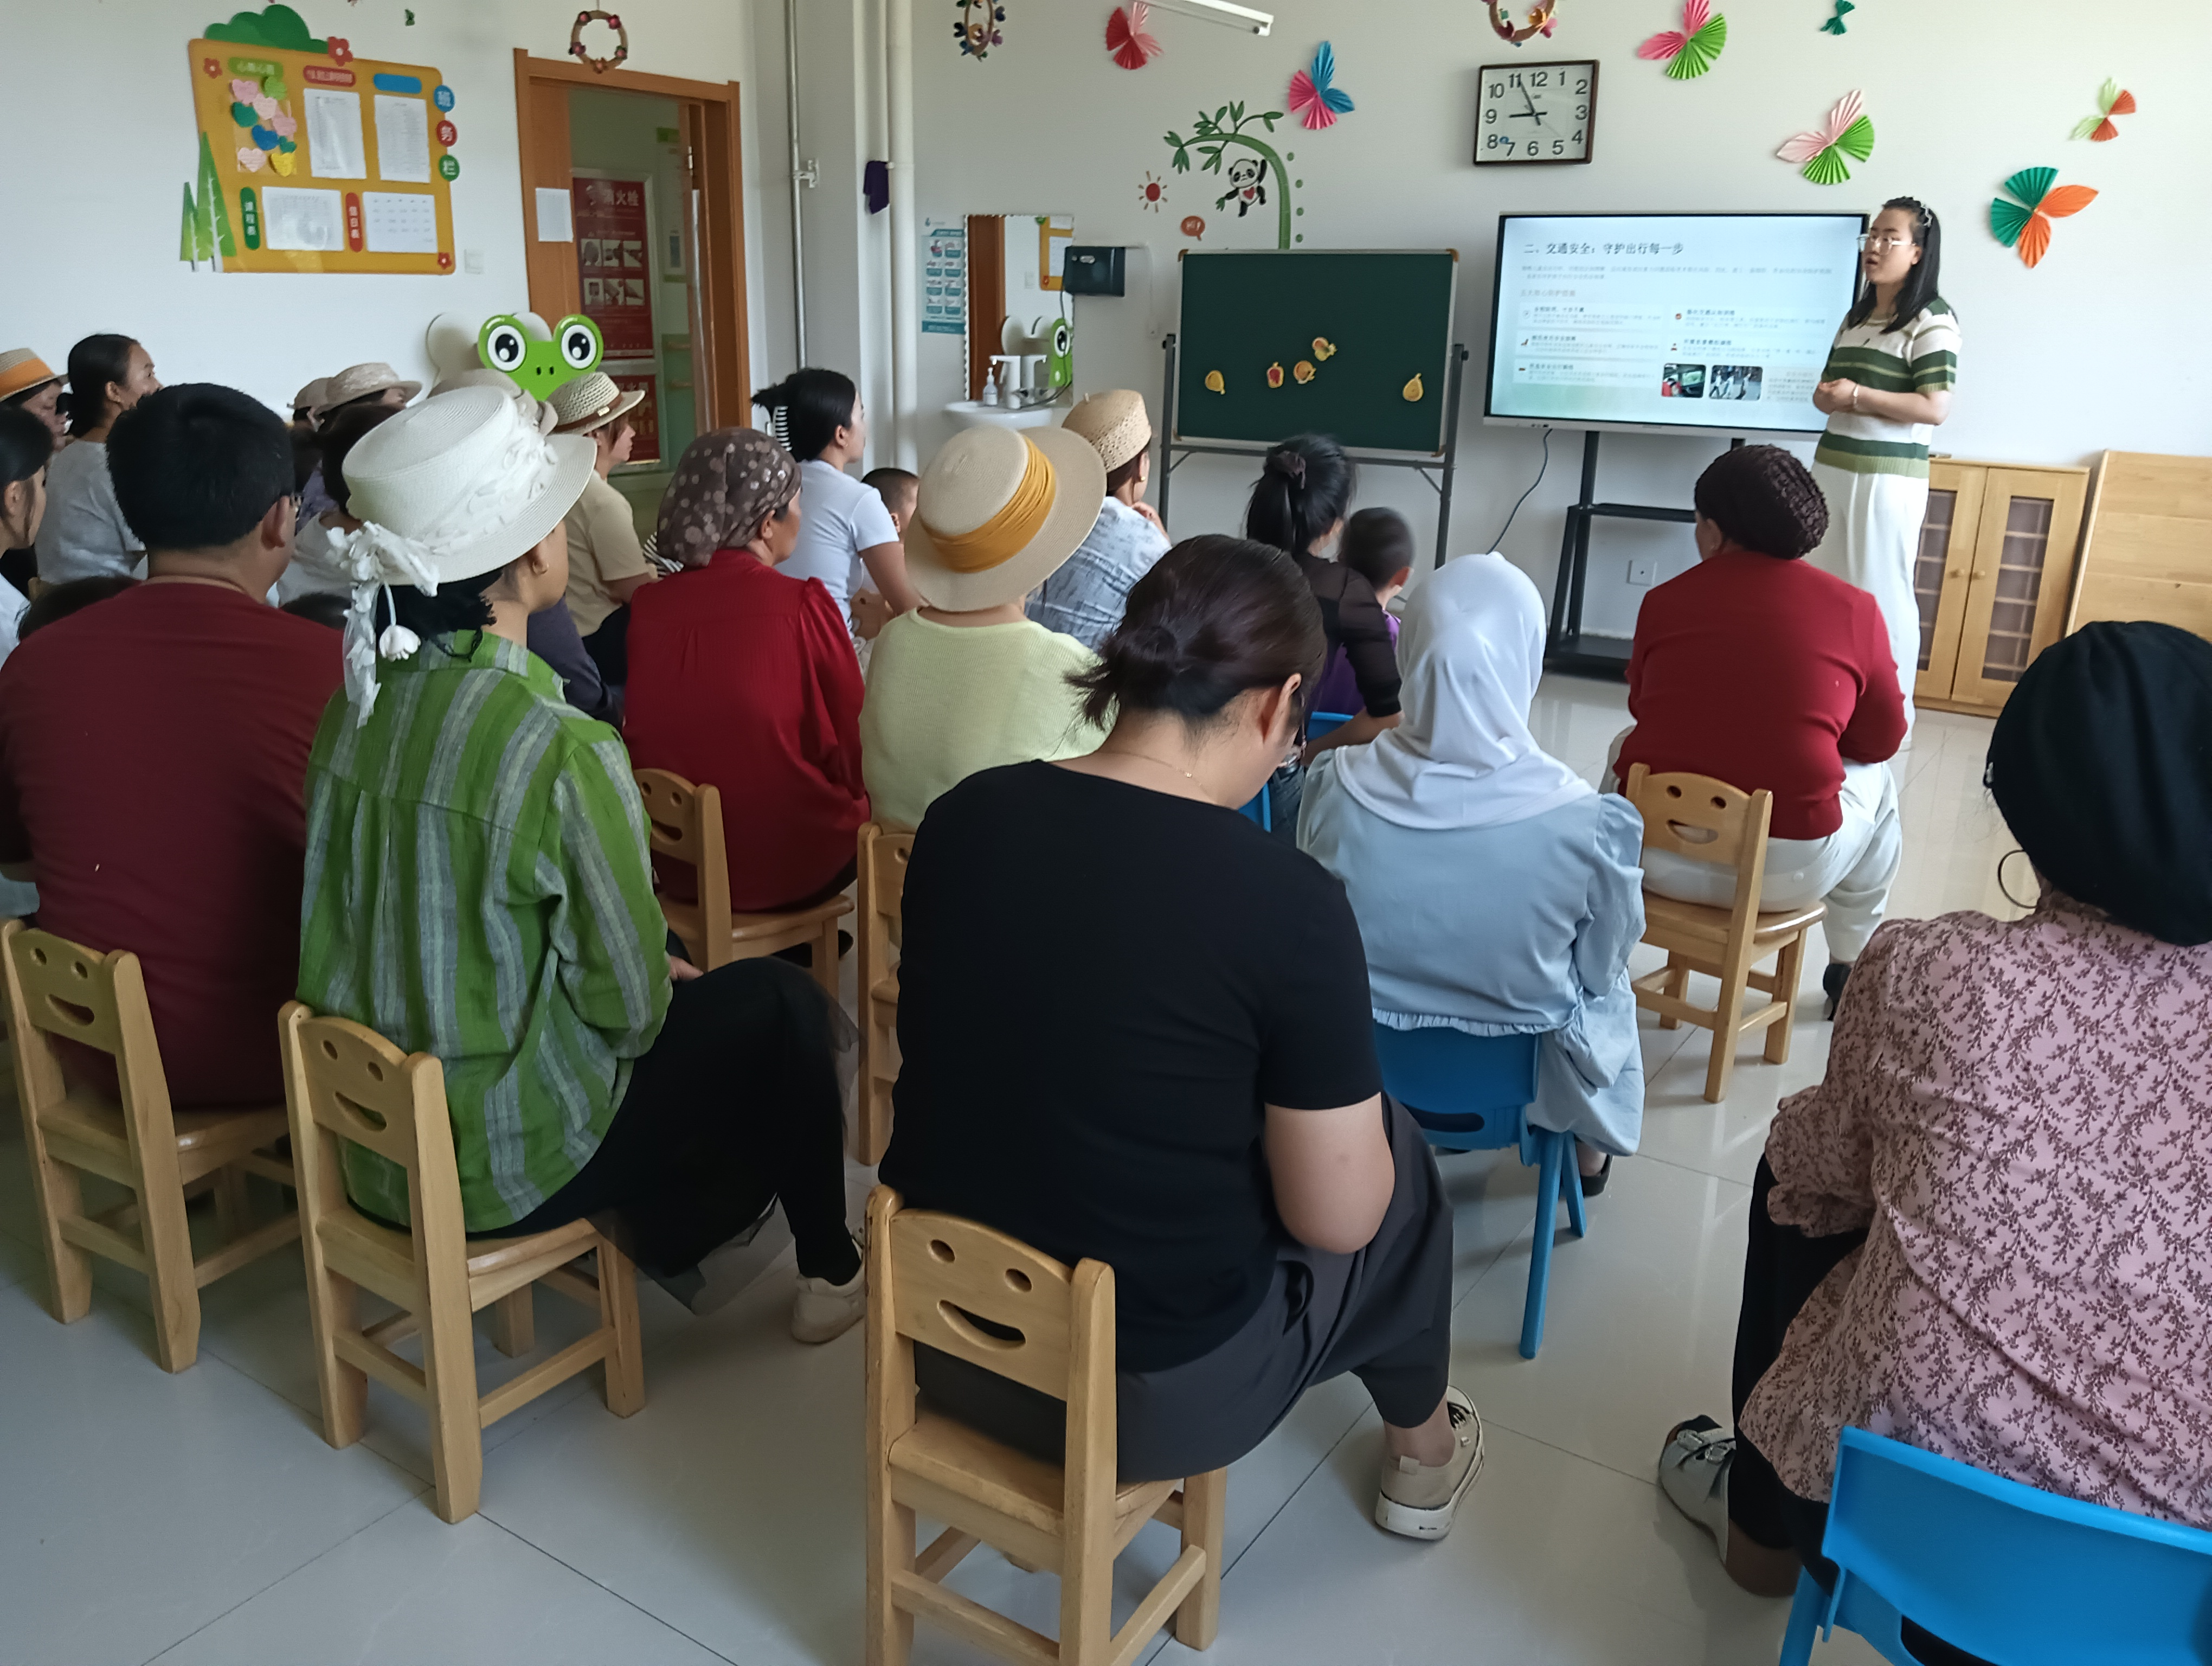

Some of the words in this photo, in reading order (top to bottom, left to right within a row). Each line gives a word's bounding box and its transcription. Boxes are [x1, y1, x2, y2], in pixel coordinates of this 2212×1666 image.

[1509, 73, 1522, 88] 11
[1530, 72, 1548, 87] 12
[1559, 71, 1565, 86] 1
[1489, 83, 1504, 98] 10
[1576, 79, 1587, 94] 2
[1486, 108, 1497, 124] 9
[1575, 105, 1587, 120] 3
[1487, 134, 1498, 149] 8
[1572, 130, 1583, 144] 4
[1504, 142, 1515, 156] 7
[1528, 141, 1539, 156] 6
[1552, 140, 1564, 155] 5
